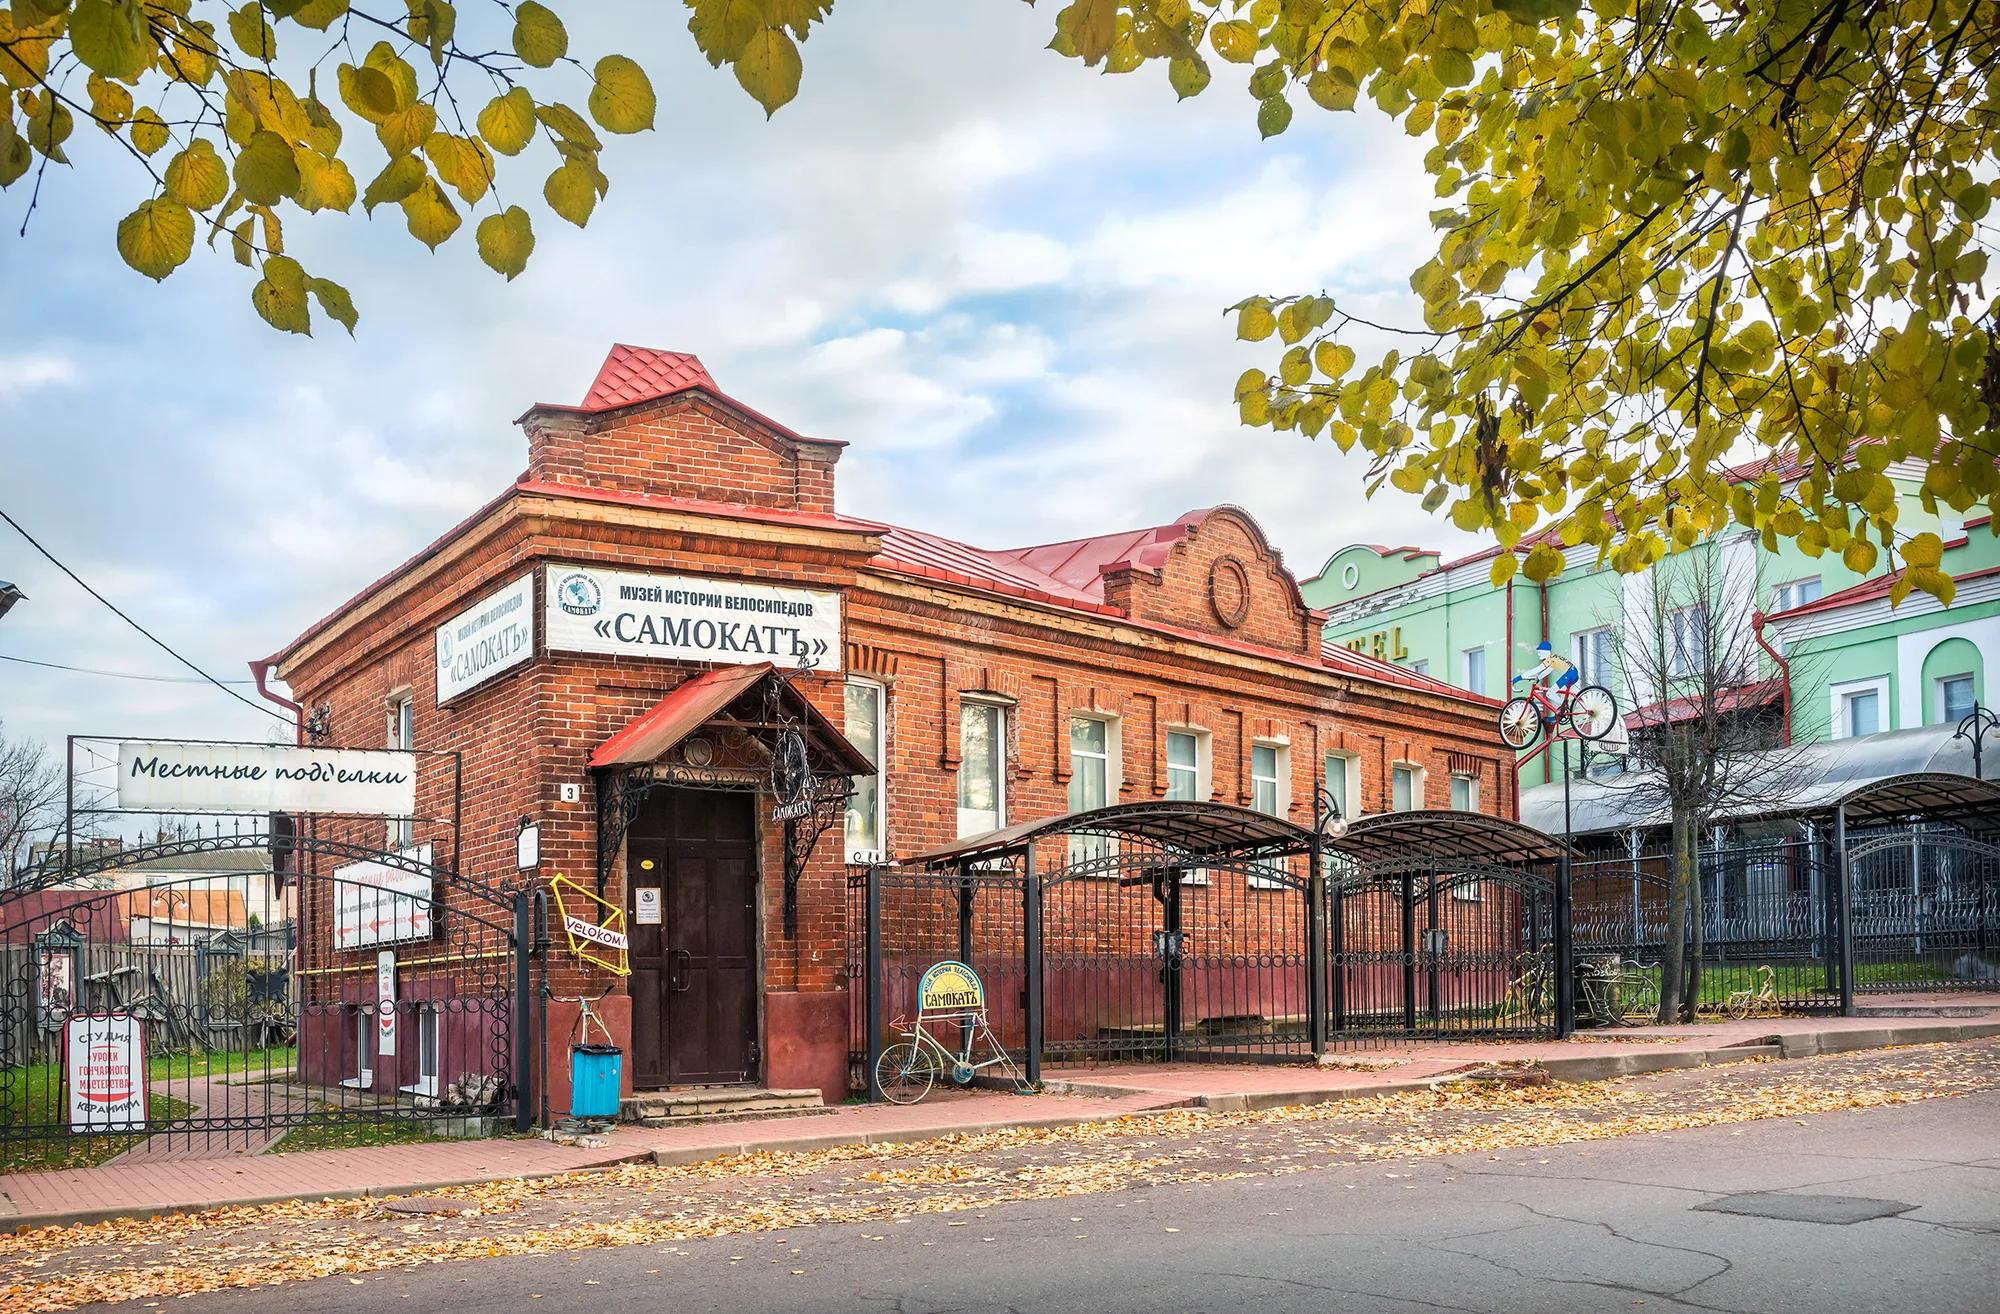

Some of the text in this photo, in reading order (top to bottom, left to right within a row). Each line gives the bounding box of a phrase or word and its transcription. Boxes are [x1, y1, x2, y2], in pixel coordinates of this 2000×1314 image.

[620, 585, 662, 603] МУЗЕЙ
[665, 590, 722, 609] ИСТОРИИ
[725, 597, 813, 617] ВЕЛОСИПЕДОВ
[594, 612, 828, 657] «САМОКАТЪ»
[450, 622, 528, 683] «САМОКАТЪ»
[131, 756, 268, 781] Местные
[567, 787, 574, 800] 3
[925, 991, 978, 1007] САМОКАТЪ
[78, 1031, 131, 1044] СТУДИЯ
[76, 1099, 140, 1114] КЕРАМИКИ
